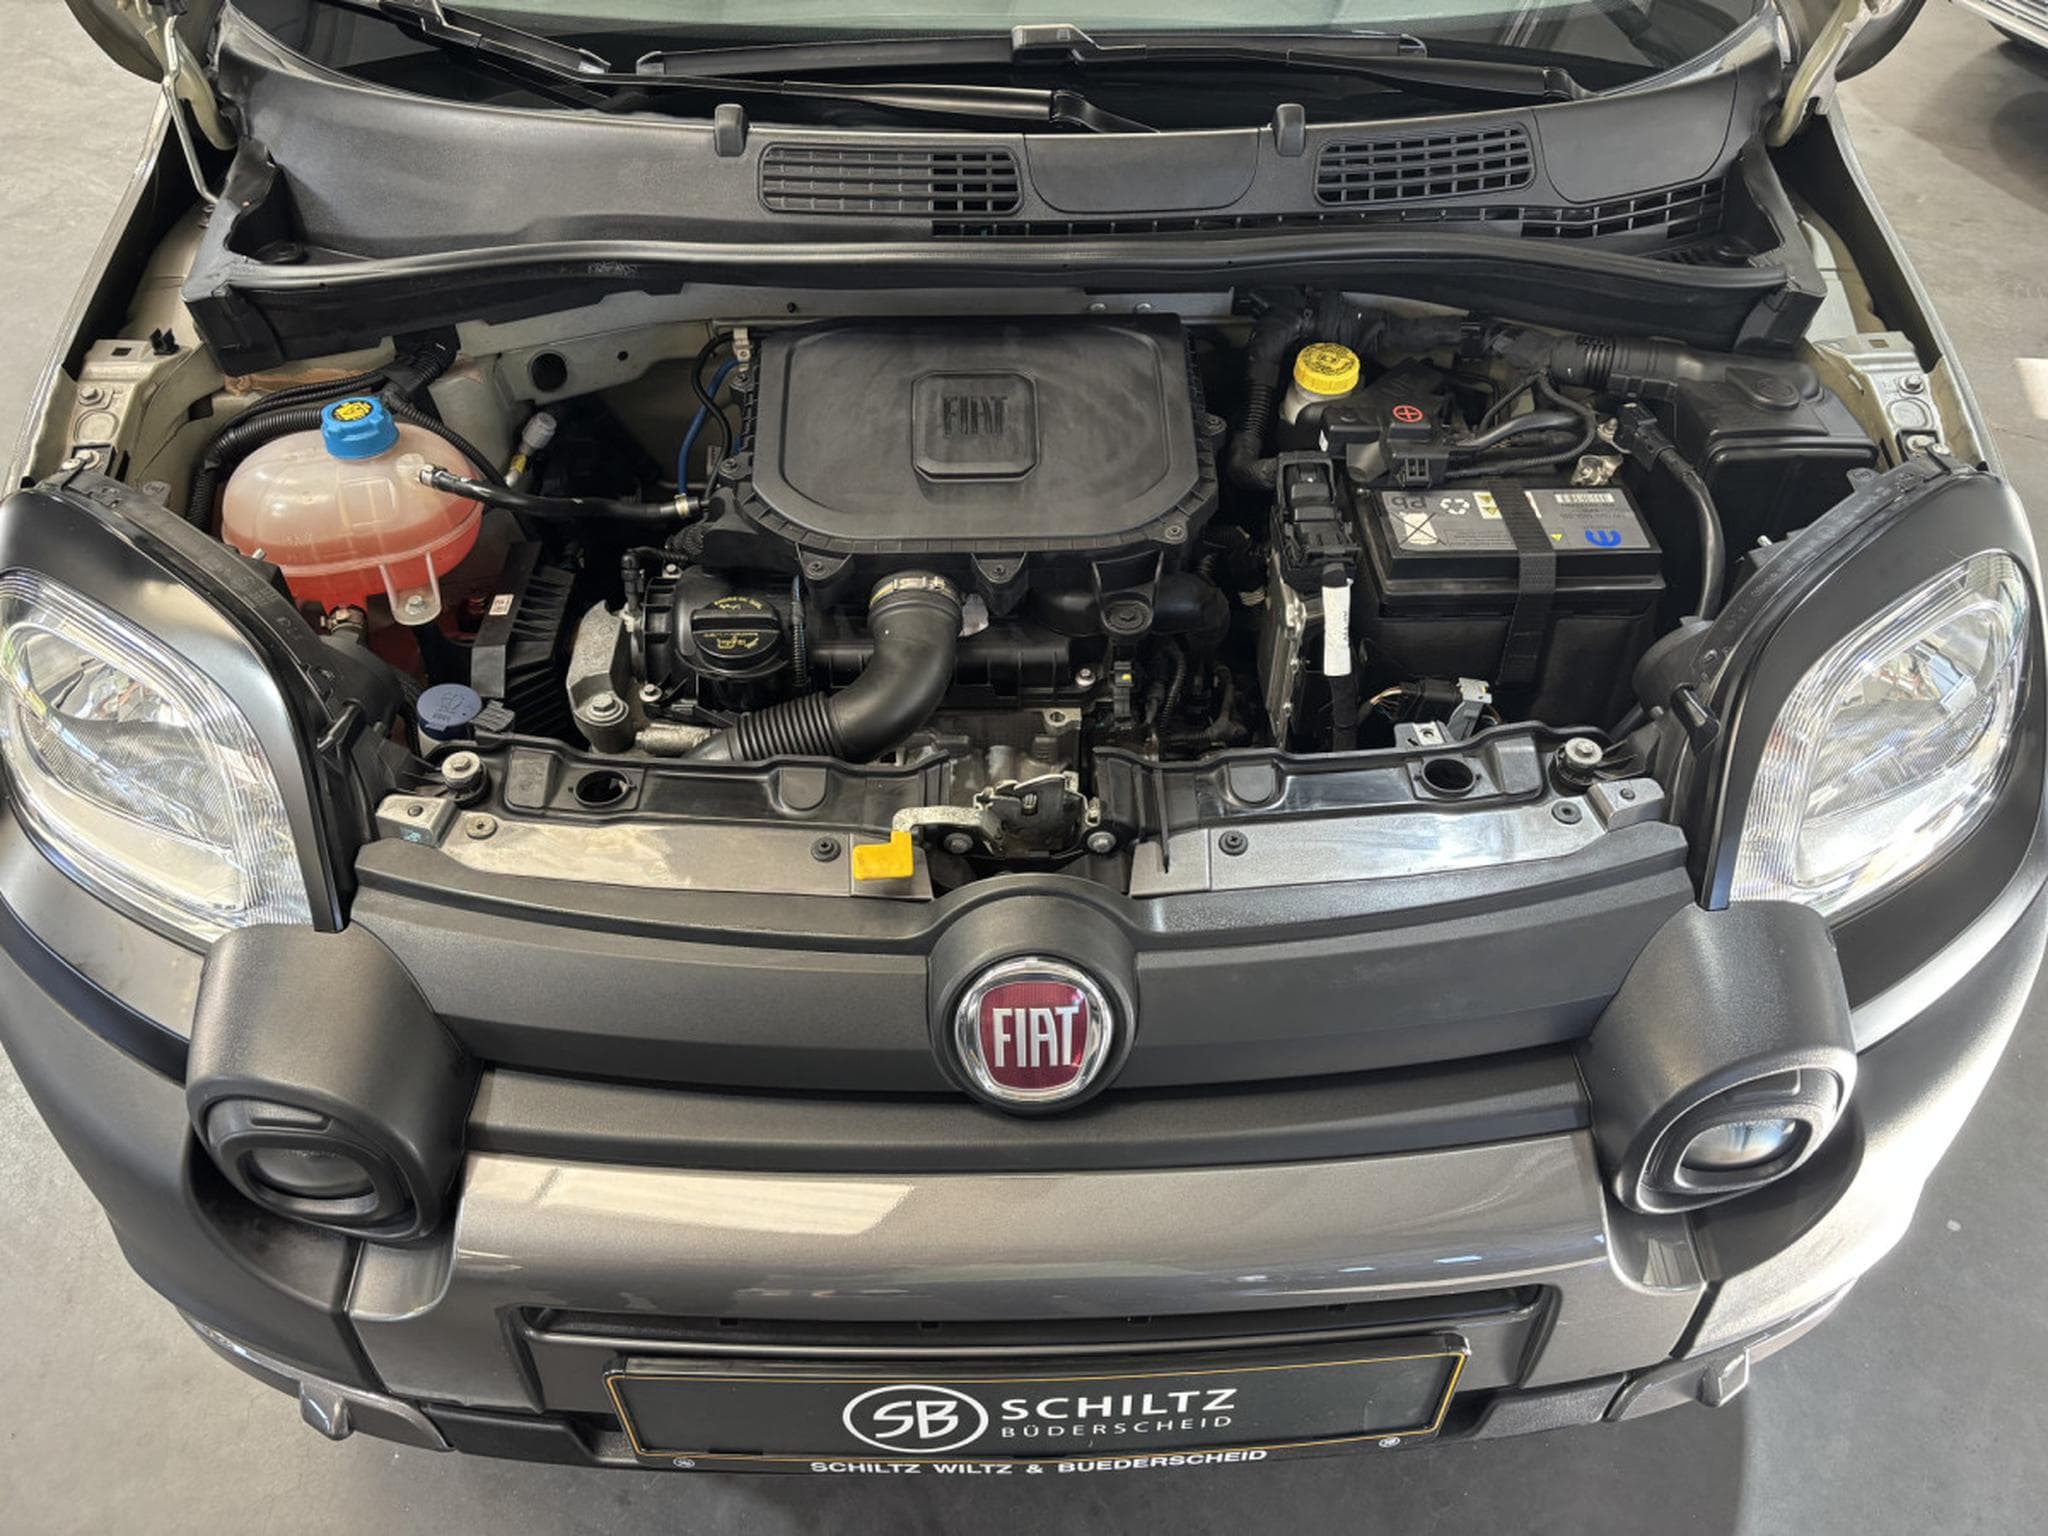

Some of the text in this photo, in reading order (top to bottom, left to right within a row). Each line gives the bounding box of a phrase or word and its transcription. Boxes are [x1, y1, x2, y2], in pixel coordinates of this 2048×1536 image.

[942, 395, 1008, 435] FIAT
[992, 1006, 1079, 1068] FIAT
[873, 1400, 958, 1439] SB
[1001, 1388, 1237, 1420] SCHILTZ
[1001, 1415, 1232, 1438] BÜDERSCHEID
[811, 1450, 1268, 1474] SCHILTZ WILTZ & BUEDERSCHEID
